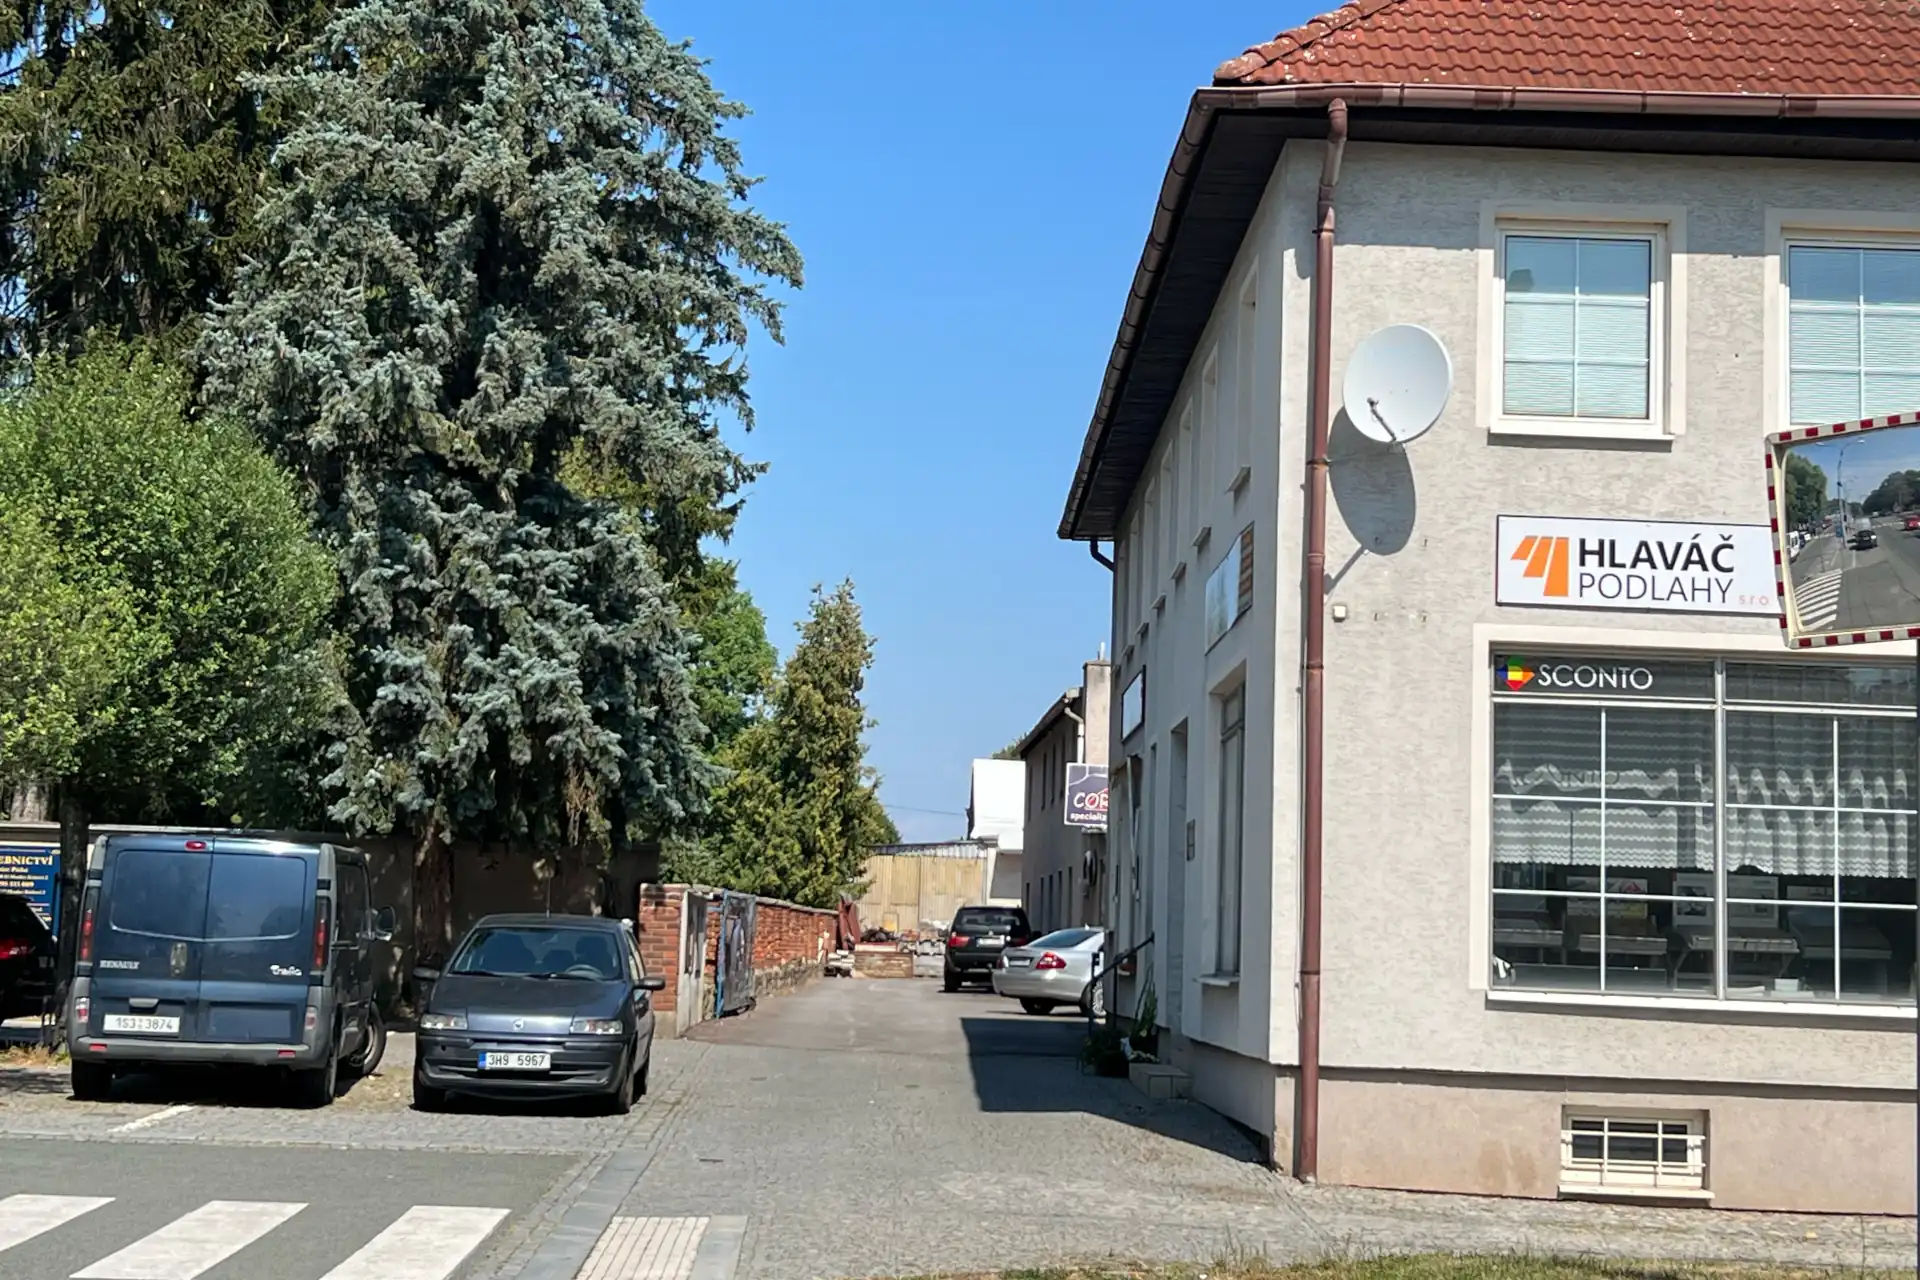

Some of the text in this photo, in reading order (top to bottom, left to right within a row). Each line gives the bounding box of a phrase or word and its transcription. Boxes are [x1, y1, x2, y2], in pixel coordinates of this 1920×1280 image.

[1579, 533, 1735, 573] HLAVÁČ
[1579, 572, 1734, 604] PODLAHY
[1538, 664, 1653, 690] SCONTO
[116, 1017, 173, 1030] 1S3 3874
[489, 1054, 546, 1066] 3H9 5967
